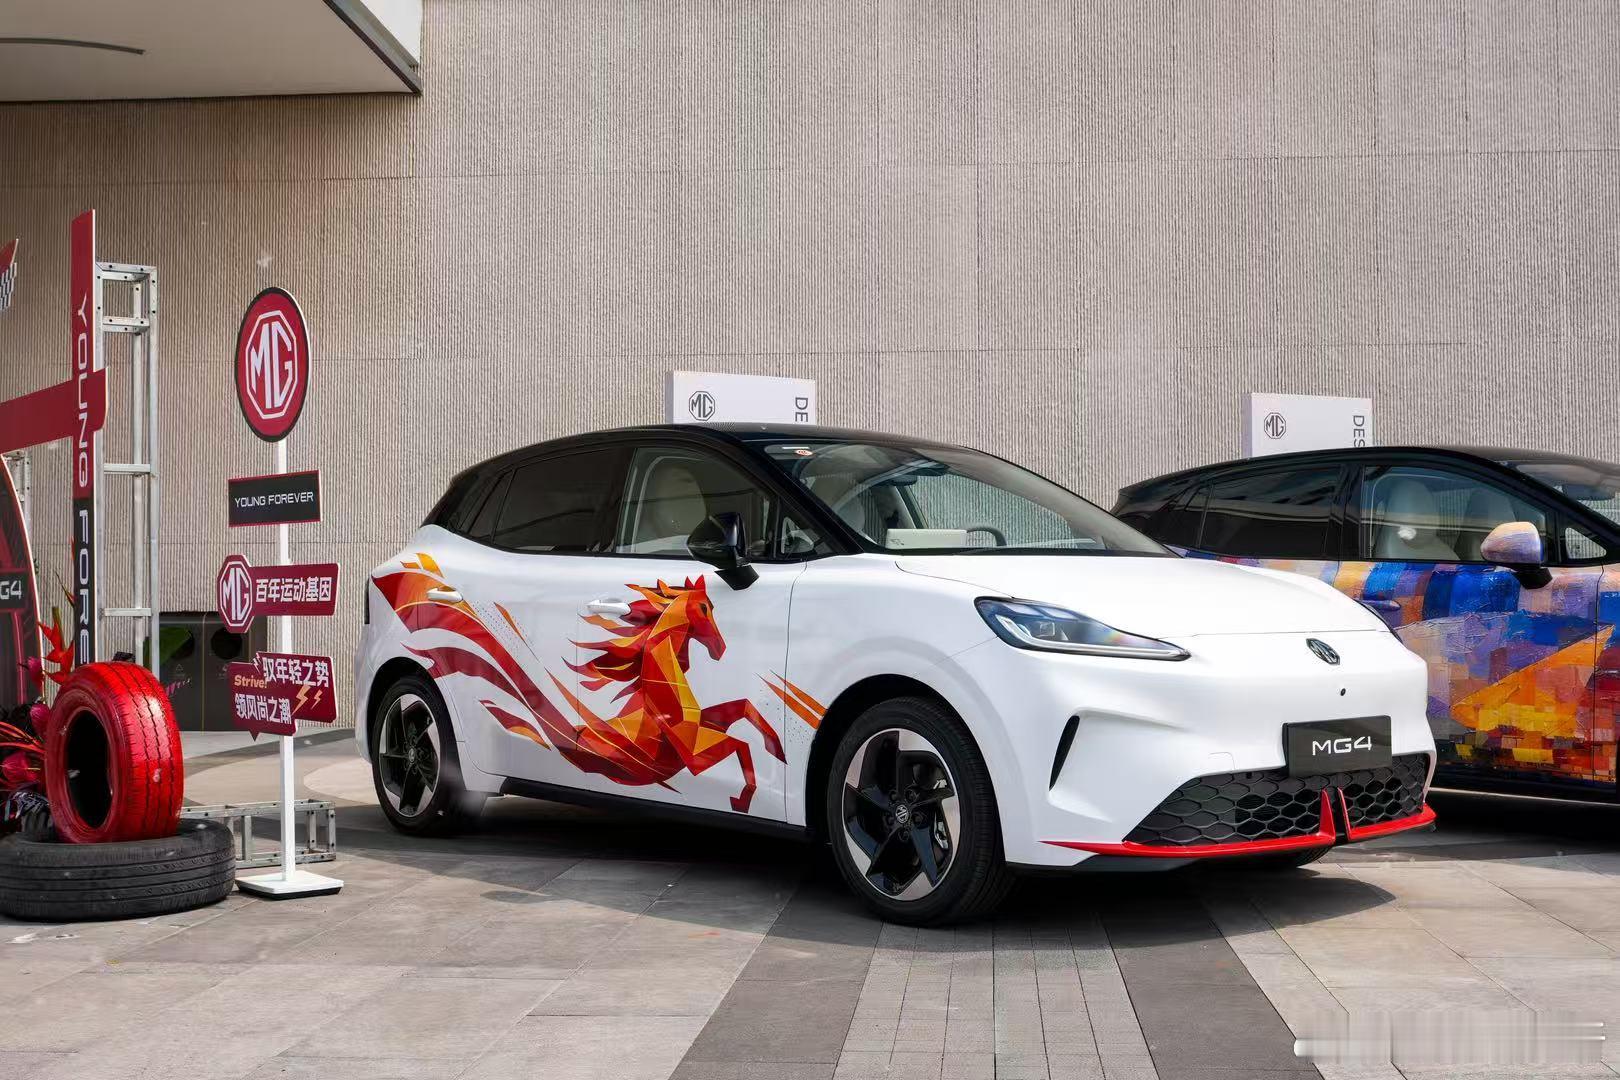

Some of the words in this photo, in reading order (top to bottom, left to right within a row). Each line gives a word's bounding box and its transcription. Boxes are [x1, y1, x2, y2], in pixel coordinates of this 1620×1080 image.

[249, 320, 293, 409] MG
[78, 292, 89, 489] YOUNG
[691, 394, 714, 418] MG
[1265, 414, 1285, 438] MG
[235, 496, 266, 508] YOUNG
[268, 491, 314, 505] FOREVER
[223, 567, 249, 621] MG
[255, 576, 332, 603] 百年运动基因
[234, 675, 268, 689] Strive!
[262, 657, 329, 688] 驭年轻之势
[234, 693, 292, 725] 领风尚之潮
[1312, 736, 1373, 756] MG4
